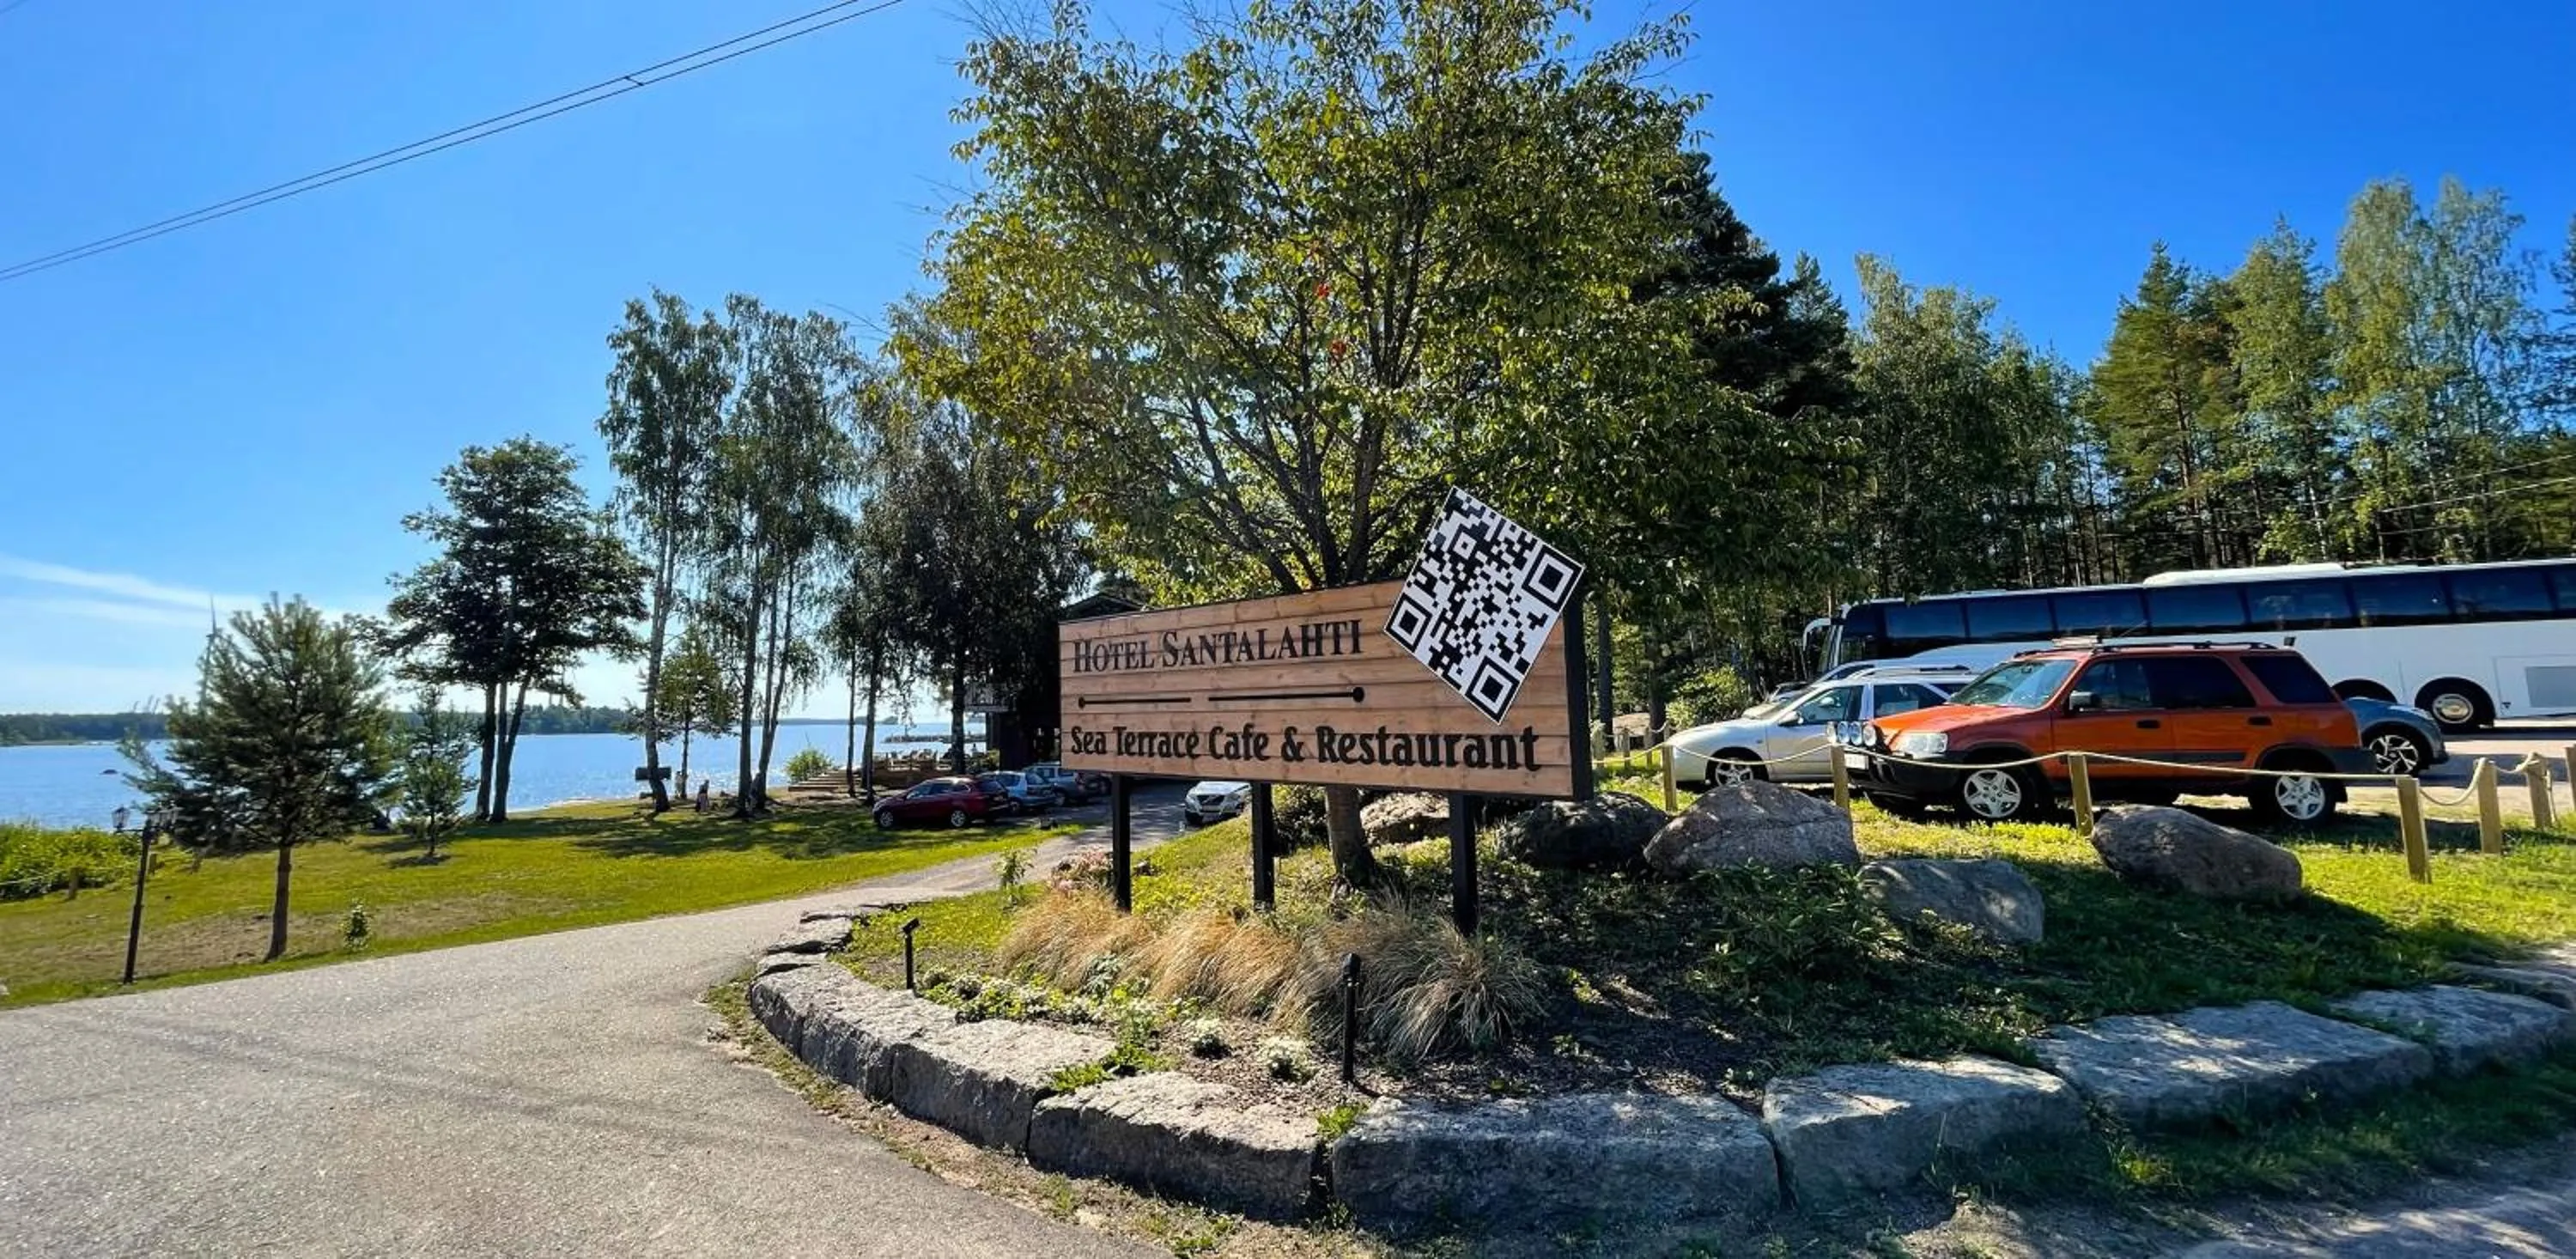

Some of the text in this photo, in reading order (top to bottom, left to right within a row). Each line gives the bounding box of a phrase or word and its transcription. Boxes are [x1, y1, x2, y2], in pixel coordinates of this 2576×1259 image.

[1073, 618, 1364, 672] HOTEL SANTALAHTI
[1071, 723, 1541, 771] Sea Terrace Cafe & Restaurant
